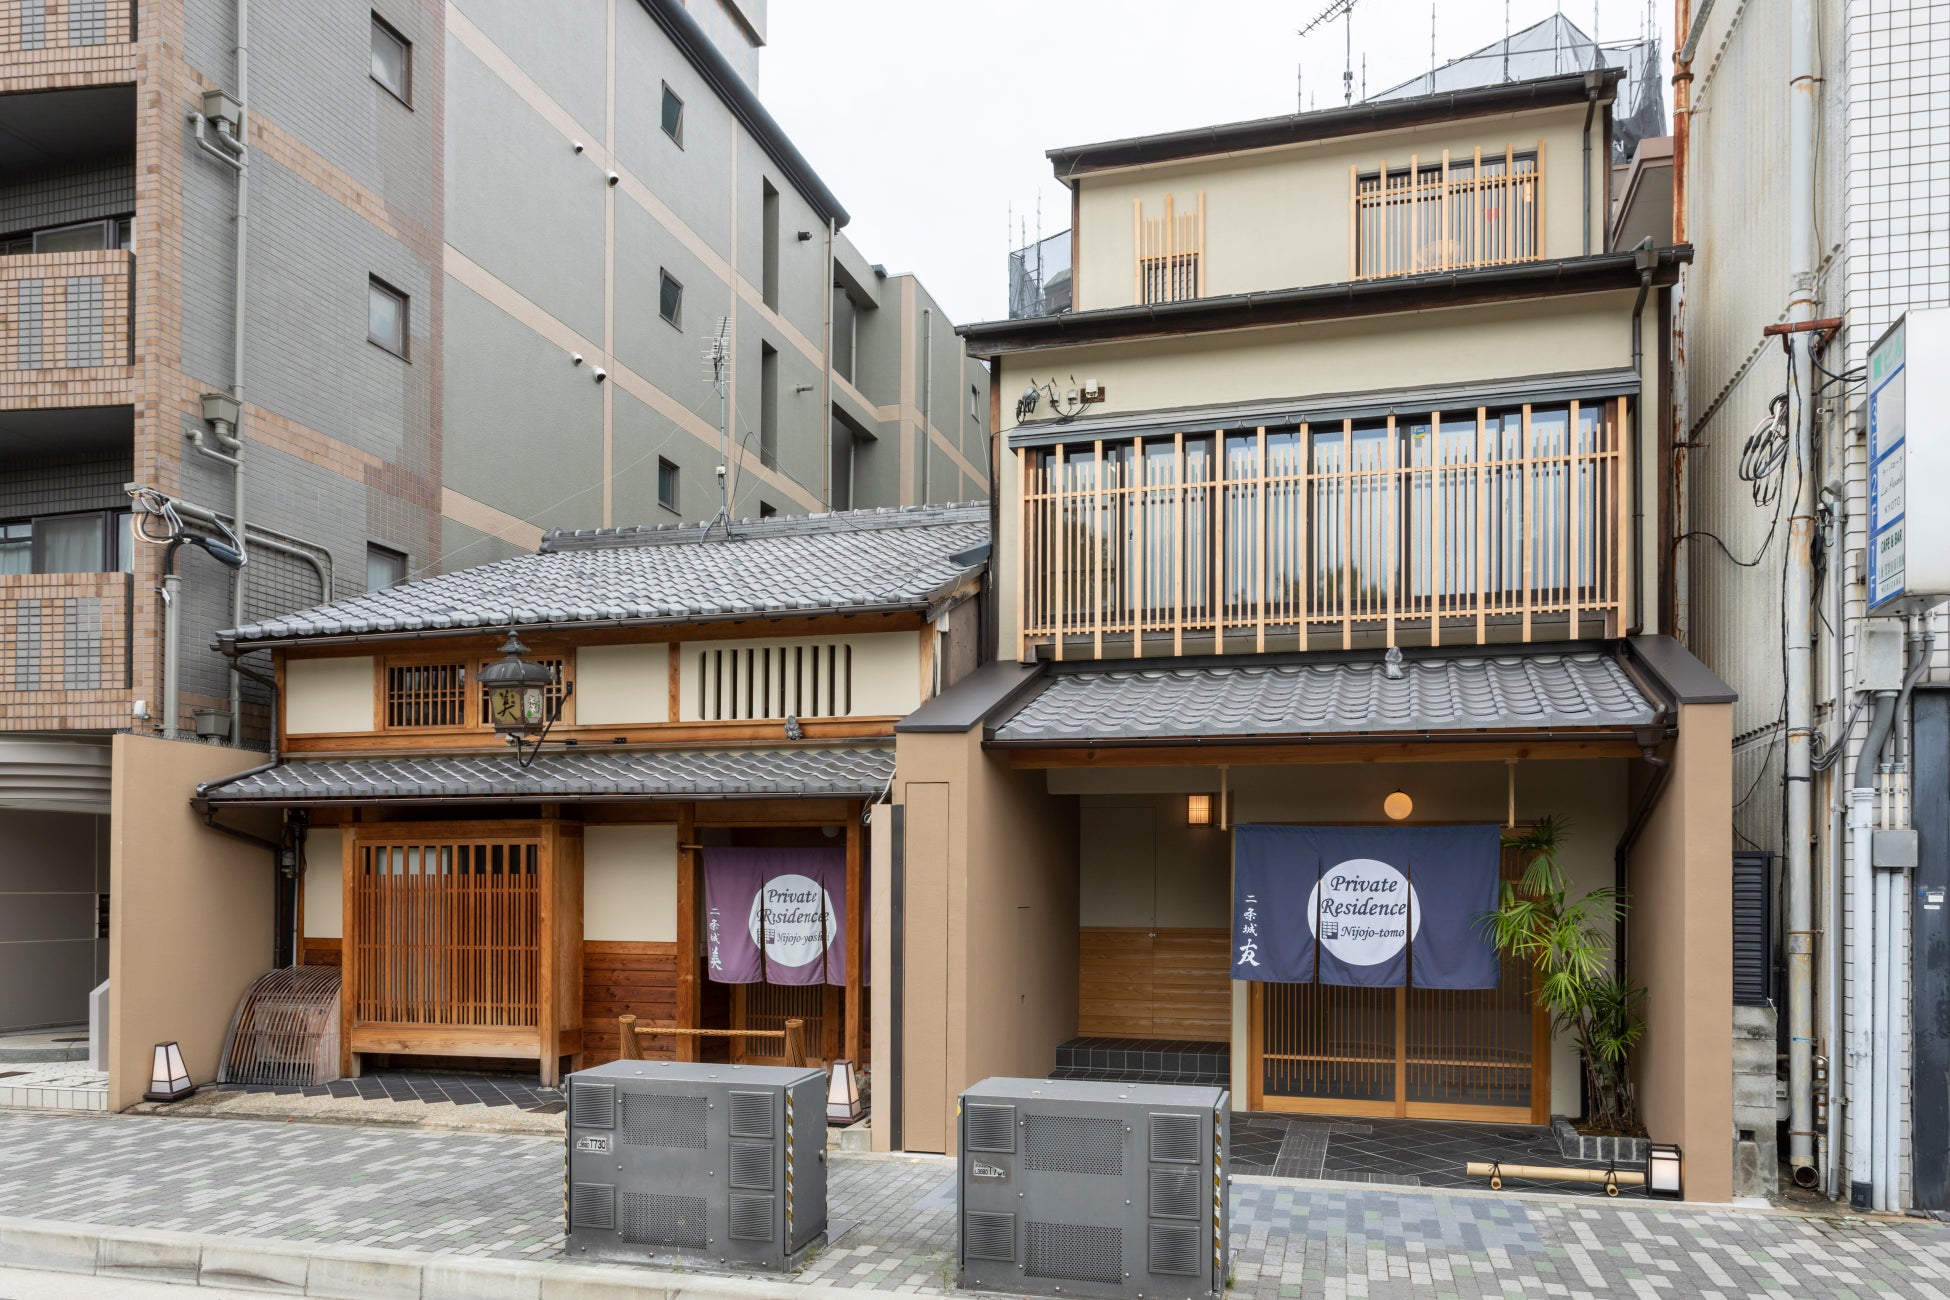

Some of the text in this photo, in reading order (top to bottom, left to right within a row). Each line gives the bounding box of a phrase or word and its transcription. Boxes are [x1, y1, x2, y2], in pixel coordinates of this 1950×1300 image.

[1881, 536, 1890, 554] CAFE
[1330, 874, 1398, 893] Private
[767, 888, 818, 904] Private
[1321, 897, 1407, 918] Residence
[1237, 894, 1260, 967] 二条城友
[1340, 926, 1405, 941] Nijojo-tomo
[590, 1138, 606, 1150] T730
